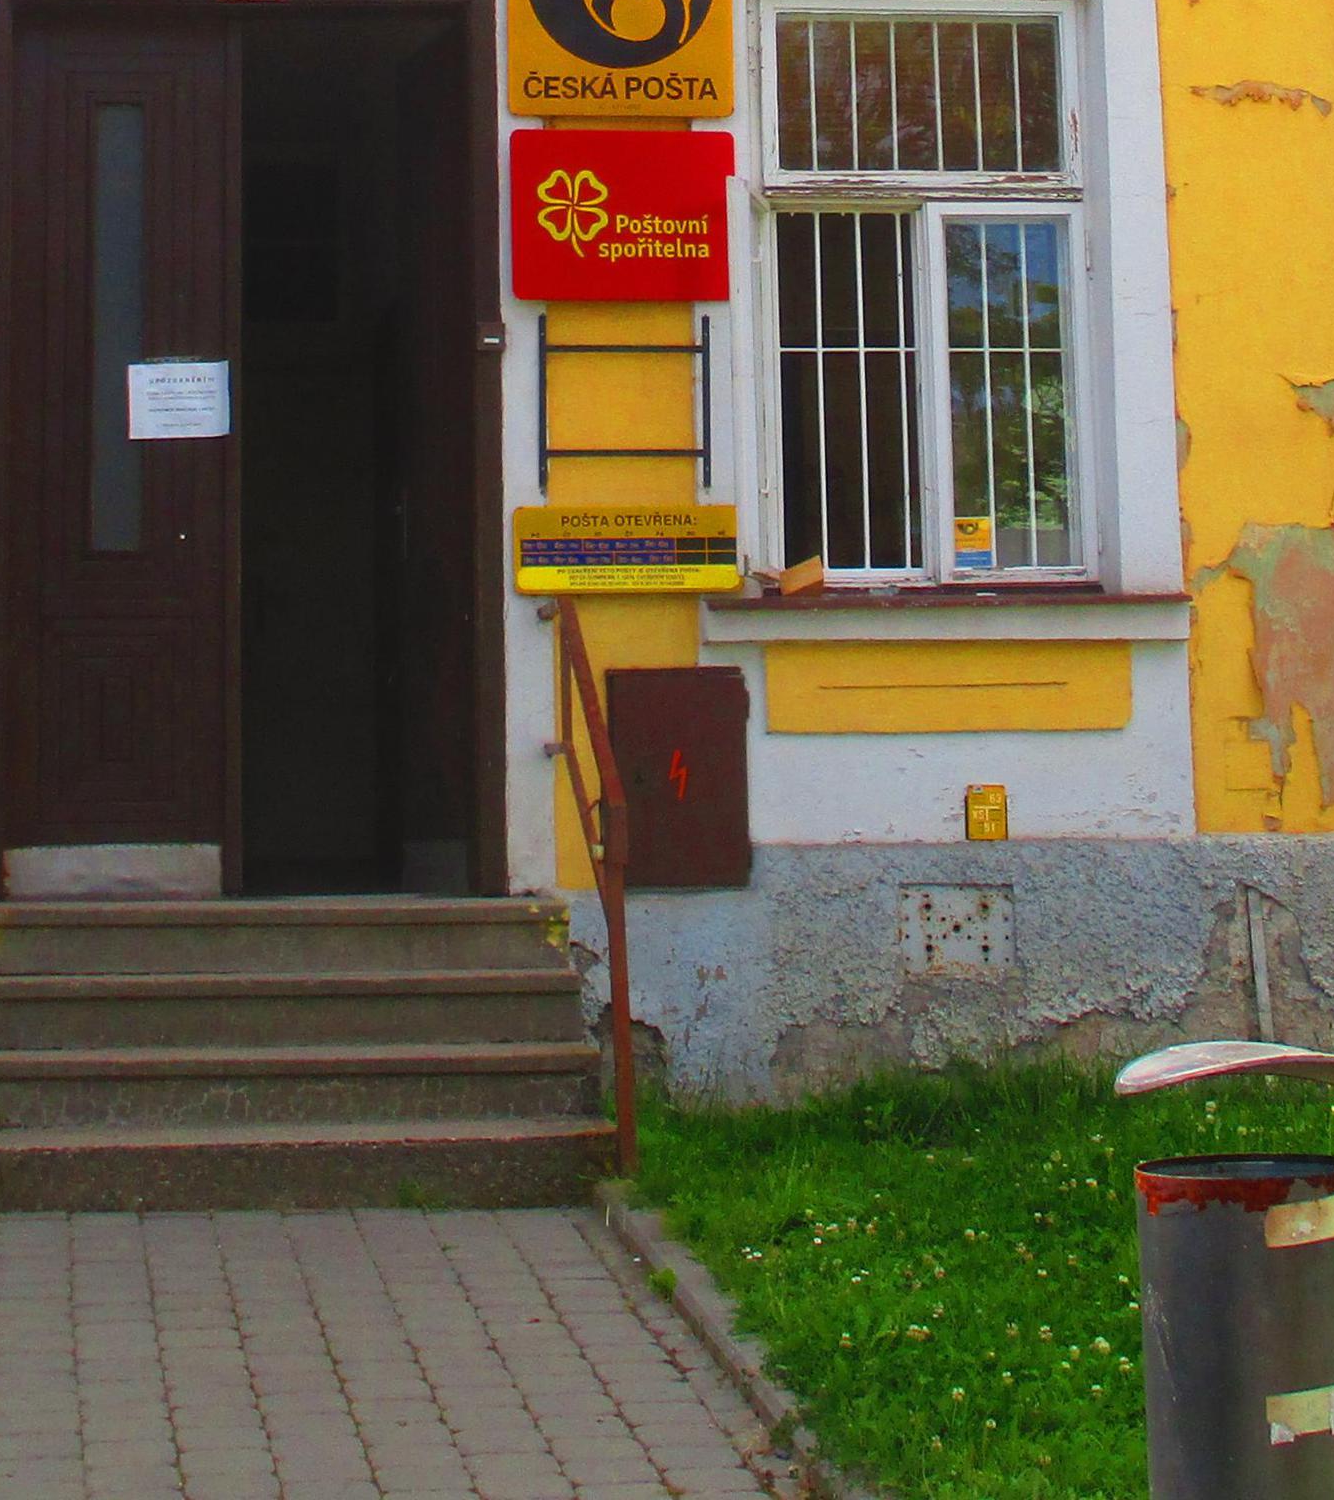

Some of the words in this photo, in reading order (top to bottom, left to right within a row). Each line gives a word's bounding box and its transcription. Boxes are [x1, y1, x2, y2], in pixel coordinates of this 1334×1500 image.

[523, 71, 617, 100] ČESKÁ
[624, 72, 718, 101] POŠTA
[615, 213, 709, 235] Poštovní
[598, 237, 710, 263] spořitelna
[560, 512, 610, 528] POŠTA
[613, 511, 698, 527] OTEVŘENA:
